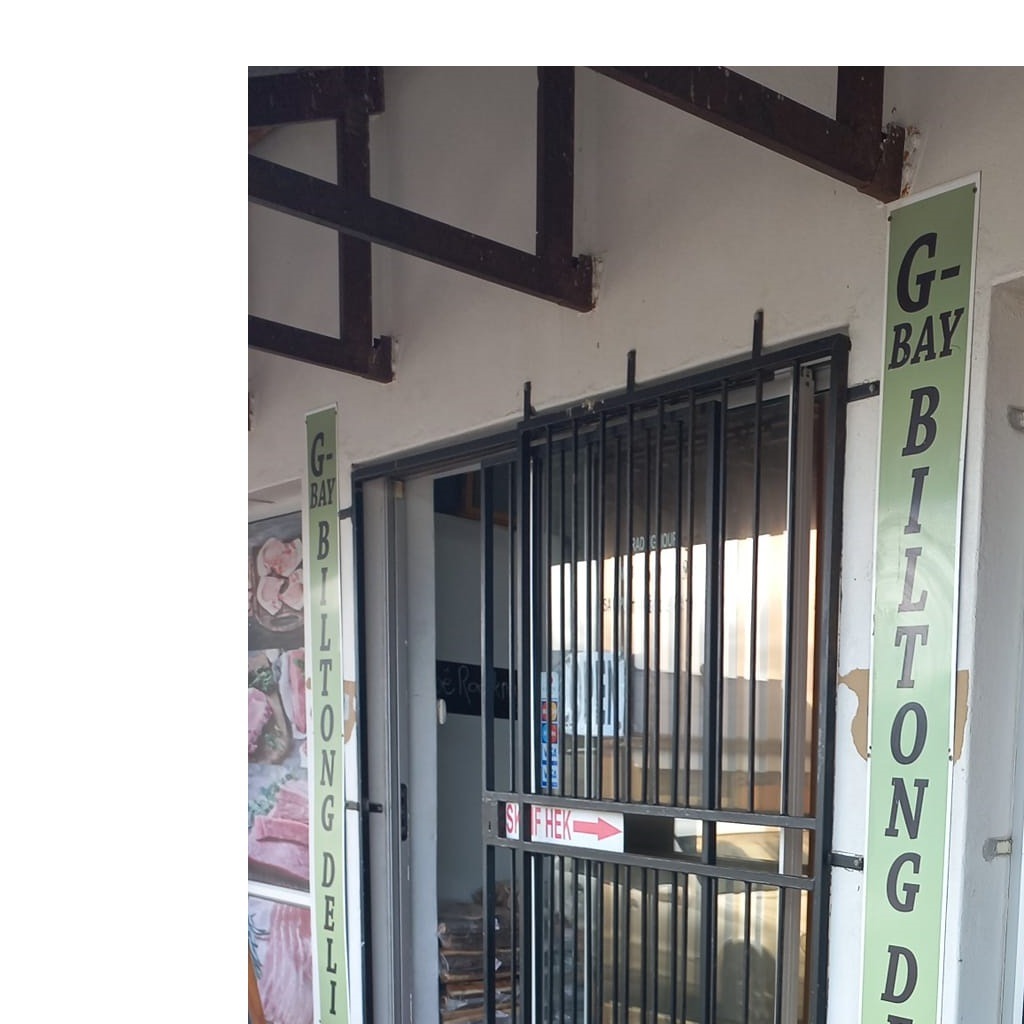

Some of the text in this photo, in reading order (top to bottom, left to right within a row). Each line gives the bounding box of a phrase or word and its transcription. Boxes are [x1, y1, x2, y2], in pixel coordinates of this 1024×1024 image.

[896, 231, 961, 313] G-
[888, 307, 965, 370] BAY
[310, 432, 333, 477] G-
[310, 477, 337, 509] BAY
[885, 386, 940, 913] BILTONG
[317, 520, 338, 1016] BILTONG DELI
[545, 807, 572, 841] HEK
